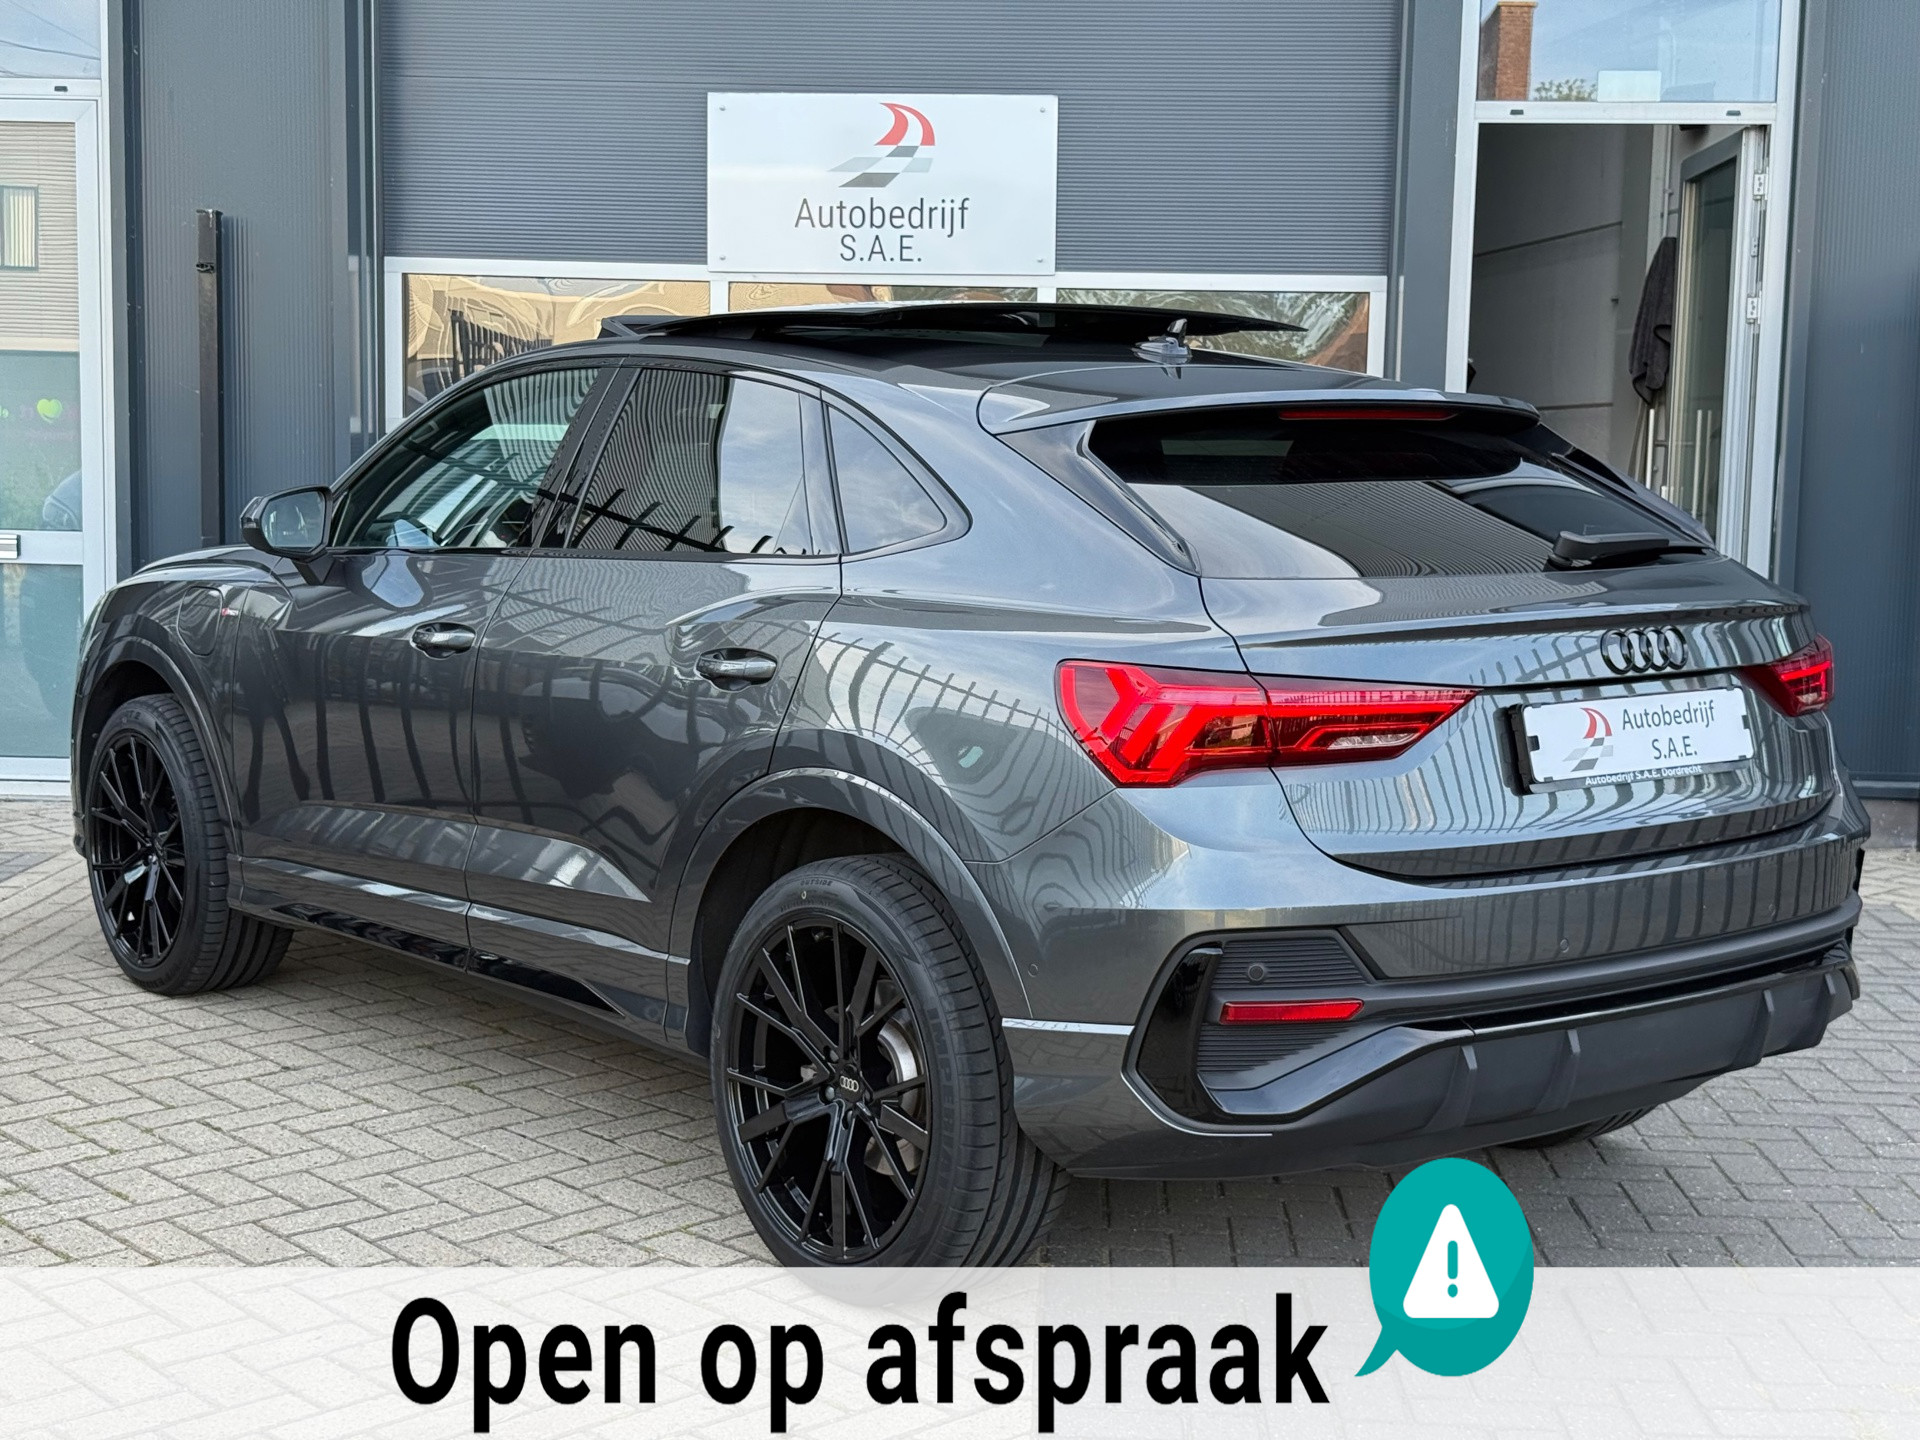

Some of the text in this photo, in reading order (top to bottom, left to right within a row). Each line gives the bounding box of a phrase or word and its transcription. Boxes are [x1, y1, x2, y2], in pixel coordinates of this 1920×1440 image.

[794, 197, 971, 238] Autobedrijf
[839, 233, 923, 263] S.A.E.
[1622, 700, 1715, 730] Autobedrijf
[1652, 736, 1698, 760] S.A.E.
[1585, 764, 1703, 786] Autobedrijf S.A.E. Dordrecht
